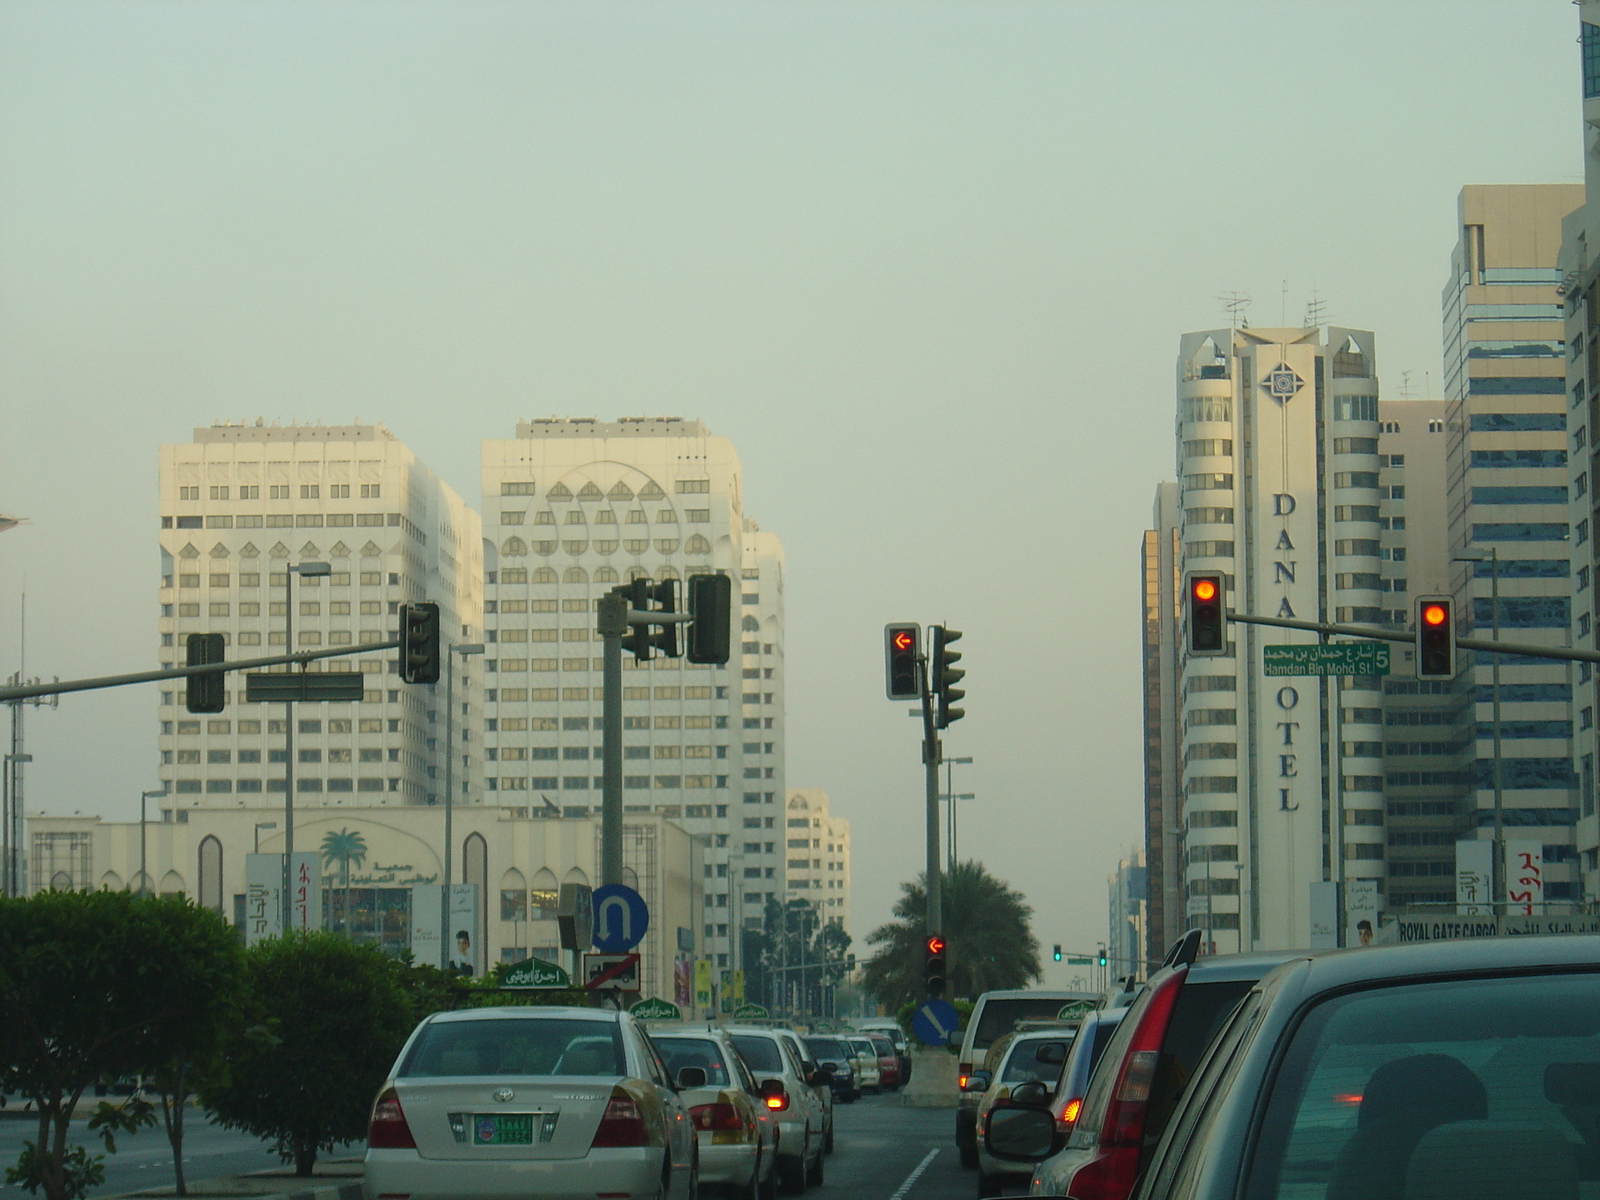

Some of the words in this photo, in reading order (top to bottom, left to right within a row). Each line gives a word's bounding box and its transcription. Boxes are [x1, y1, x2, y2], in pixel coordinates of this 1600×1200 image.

[1273, 493, 1297, 618] DANA
[1264, 649, 1294, 660] محمد
[1295, 648, 1308, 662] بن
[1309, 646, 1343, 661] حمدان
[1346, 645, 1373, 662] شارع
[1375, 651, 1388, 668] 5
[1264, 664, 1306, 675] Hamdan
[1308, 663, 1324, 675] Bin
[1327, 663, 1357, 675] Mohd.
[1359, 663, 1373, 675] St.
[1276, 685, 1300, 811] OTEL
[1400, 923, 1430, 941] ROYAL
[1433, 923, 1461, 939] GATE
[1462, 923, 1496, 937] CARGO
